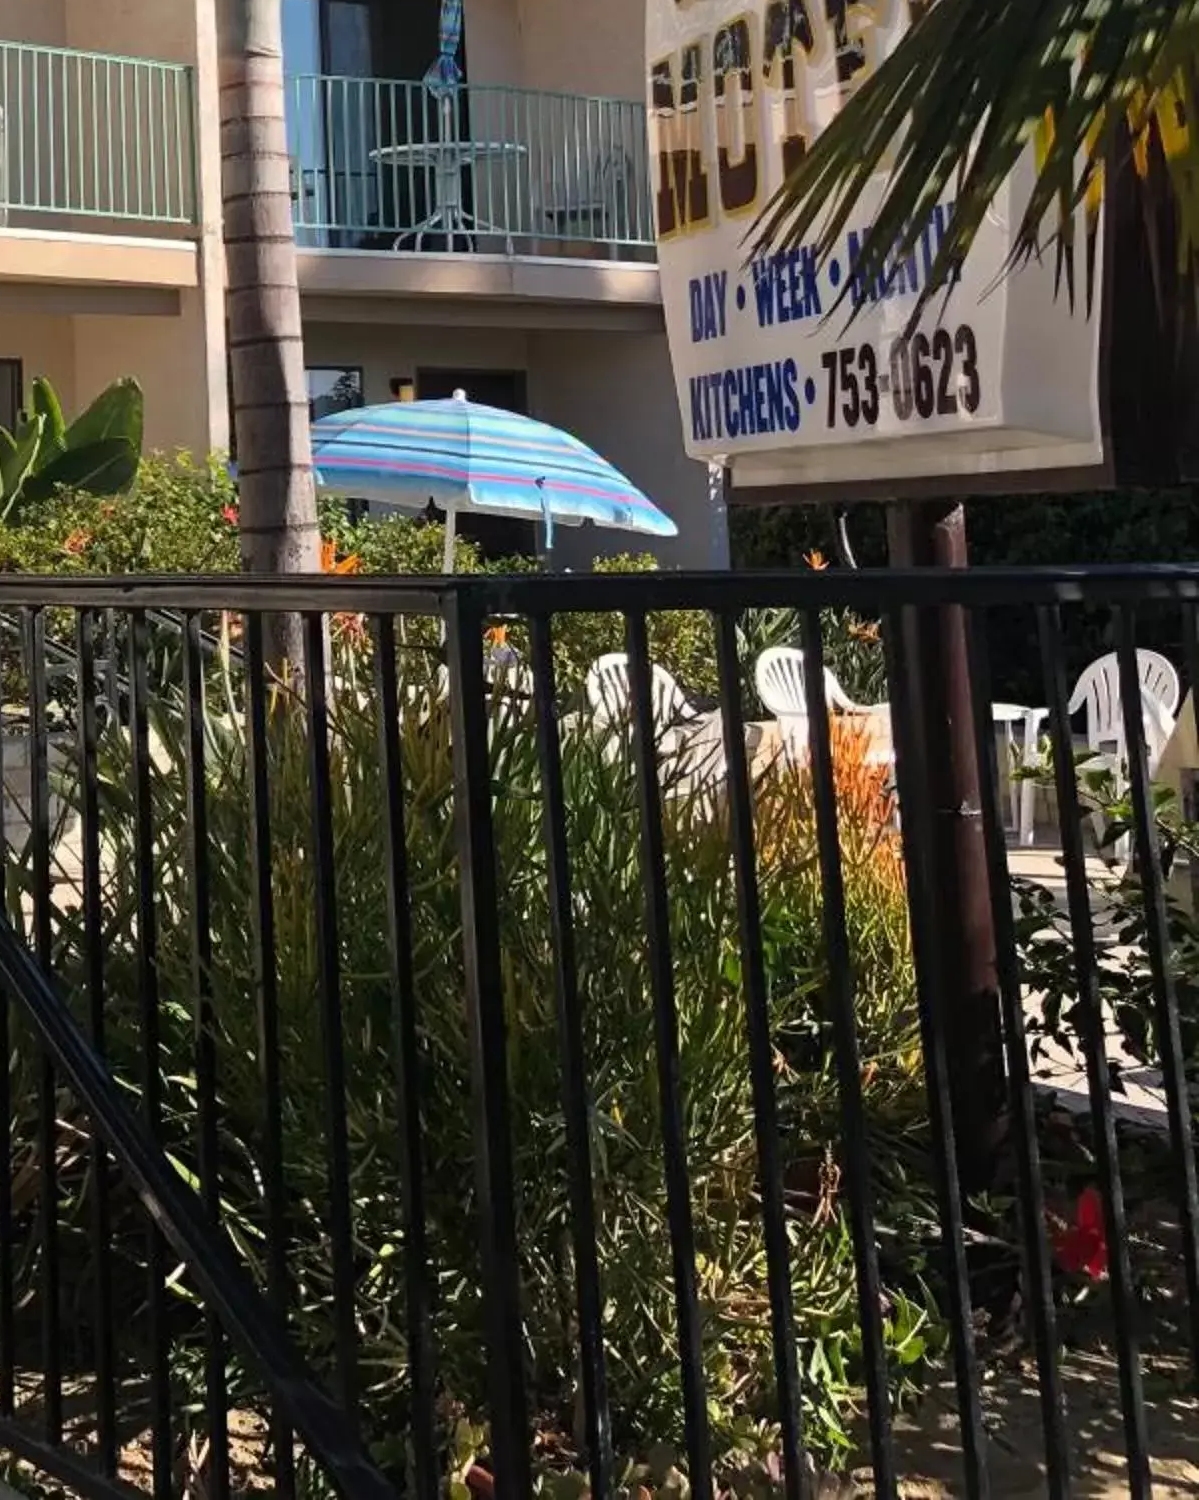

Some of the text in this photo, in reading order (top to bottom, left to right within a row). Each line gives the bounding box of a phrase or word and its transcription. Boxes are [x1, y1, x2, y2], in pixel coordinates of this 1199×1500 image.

[688, 270, 727, 343] DAY
[751, 243, 823, 328] WEEK
[689, 323, 980, 441] KITCHENS 753-0623
